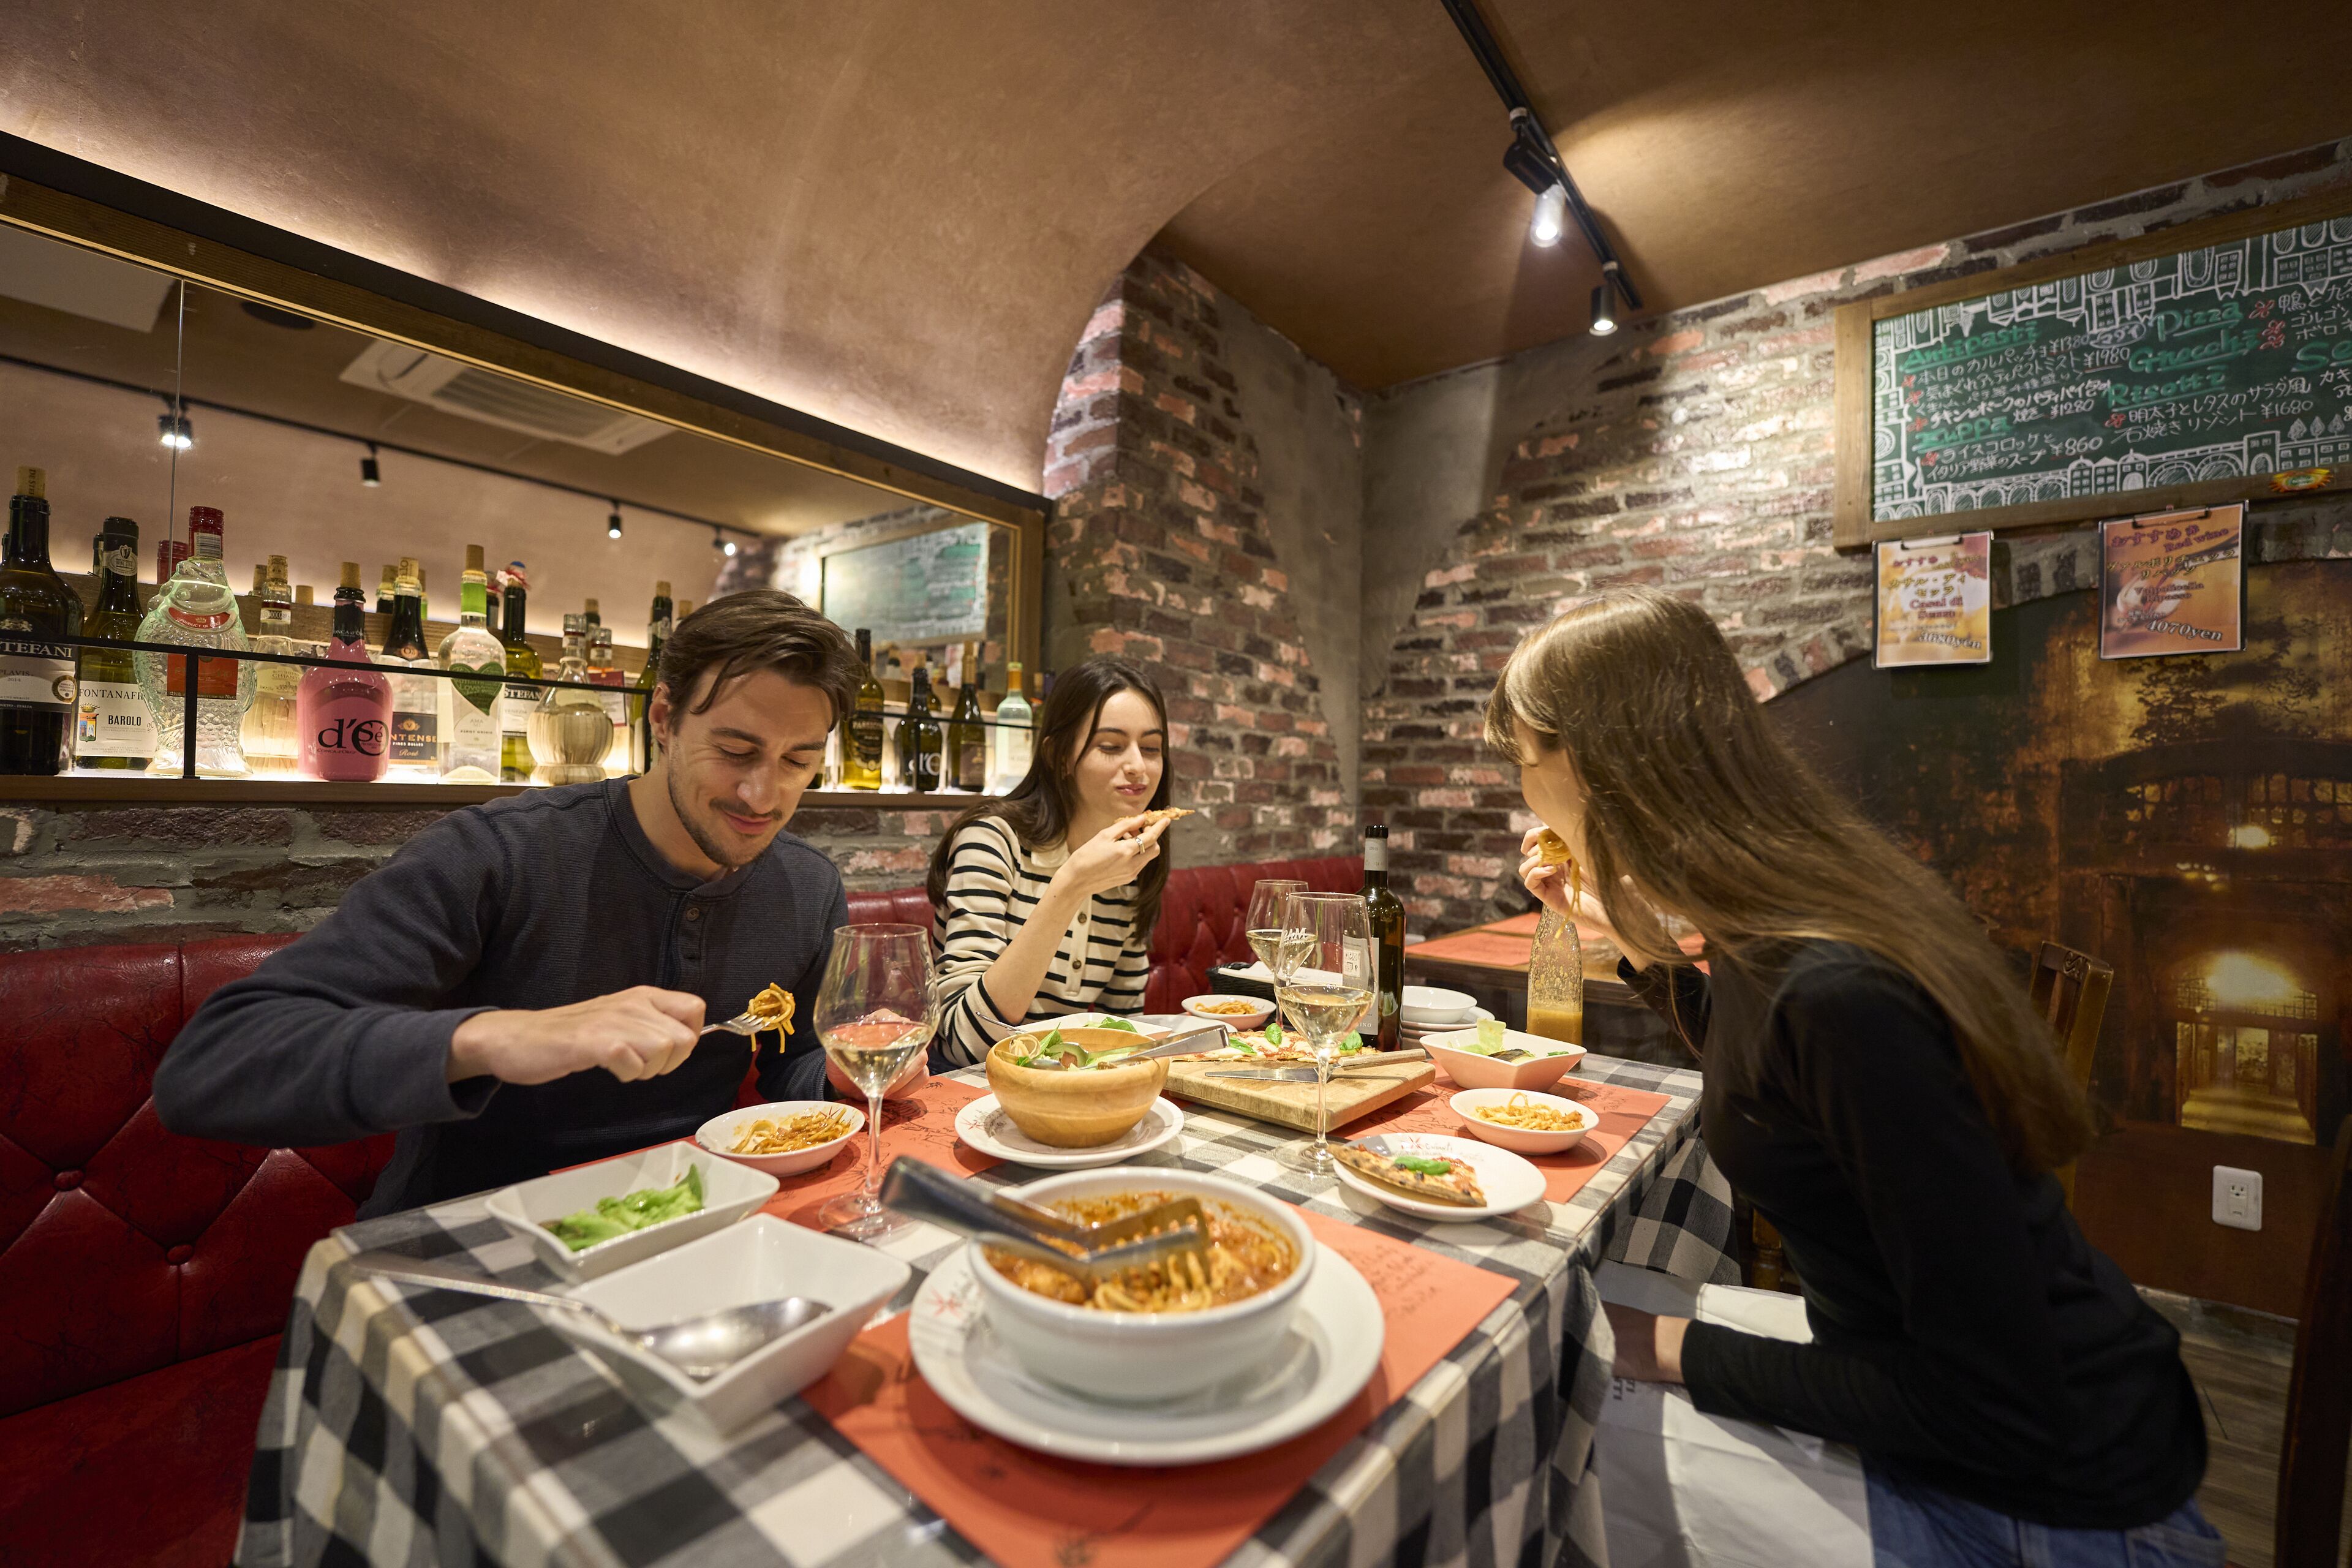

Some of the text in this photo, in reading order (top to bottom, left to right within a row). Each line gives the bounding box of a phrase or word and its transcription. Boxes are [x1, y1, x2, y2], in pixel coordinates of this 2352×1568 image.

[2149, 301, 2244, 341] Pizza
[1901, 321, 2041, 369] Antipasti
[2084, 346, 2130, 368] ¥1980
[2051, 399, 2094, 420] ¥1280
[2261, 400, 2314, 420] ¥1680
[2051, 436, 2103, 456] ¥860
[2146, 619, 2223, 642] 4070yen
[0, 642, 72, 658] TEFANI
[108, 715, 141, 726] BAROLO
